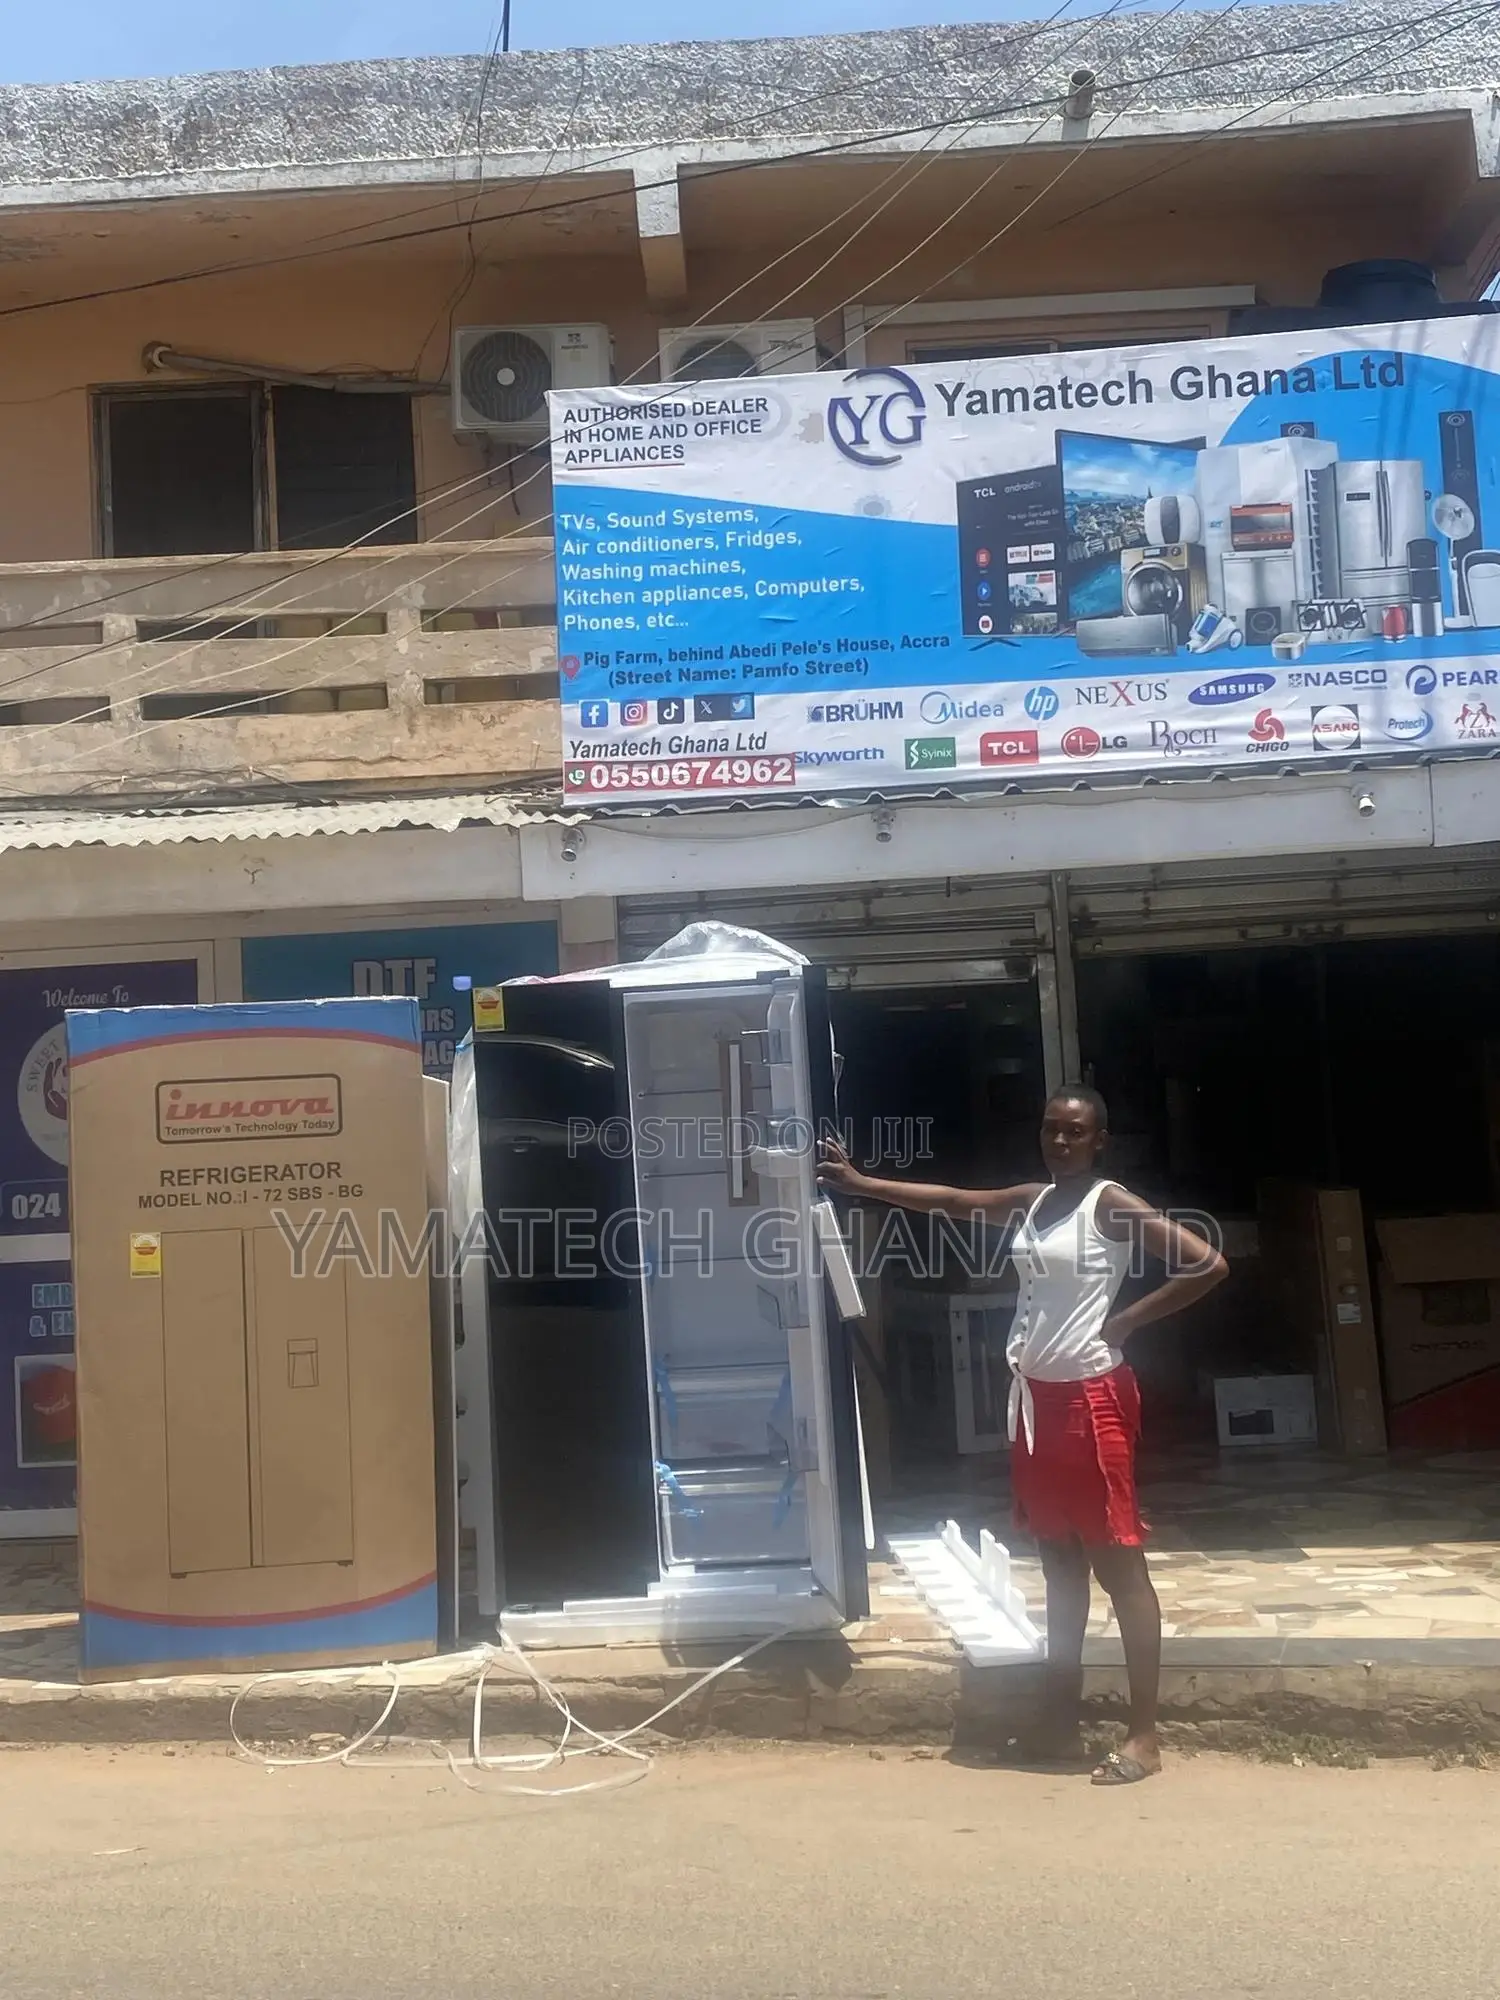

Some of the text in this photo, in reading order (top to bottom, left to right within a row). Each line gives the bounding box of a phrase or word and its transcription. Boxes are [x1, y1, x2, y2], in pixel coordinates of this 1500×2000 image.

[935, 353, 1404, 417] Yamatech Ghana Ltd
[563, 398, 769, 423] AUTHORISED DEALER
[830, 392, 927, 446] YG
[564, 419, 762, 444] IN HOME AND OFFICE
[564, 444, 685, 464] APPLIANCES
[974, 487, 996, 498] TCL
[560, 507, 759, 533] TVs, Sound Systems,
[562, 530, 802, 557] Air conditioners, Fridges,
[563, 559, 746, 583] Washing machines,
[563, 577, 865, 606] Kitchen appliances, Computers,
[564, 612, 689, 632] Phones, etc...
[584, 635, 950, 669] Pig Farm, behind Abedi Pele's House, Accra
[608, 659, 869, 688] (Street Name: Pamfo Street)
[1305, 669, 1387, 687] NASCO
[1442, 670, 1500, 687] PEAR
[1075, 681, 1168, 707] NEXUS
[1199, 682, 1265, 696] SAMSUNG
[825, 699, 903, 723] BRÜHM
[934, 701, 1004, 721] Midea
[1028, 687, 1056, 720] hp
[1312, 722, 1359, 733] ASANO
[1387, 716, 1425, 730] Protech
[1458, 728, 1496, 739] ZARA
[569, 731, 767, 759] Yamatech Ghana Ltd
[795, 747, 885, 766] Skyworth
[921, 748, 952, 758] Syinix
[988, 741, 1030, 755] TCL
[1246, 741, 1289, 753] CHIGO
[590, 757, 792, 788] 0550674962
[353, 958, 437, 999] DTF
[42, 984, 129, 1008] Welcome To
[27, 1039, 60, 1093] SWEET
[166, 1089, 335, 1121] innova
[165, 1119, 335, 1137] Tomorrow's Technology Today
[160, 1162, 342, 1187] REFRIGERATOR
[11, 1192, 61, 1220] 024
[139, 1194, 201, 1209] MODEL
[264, 1188, 282, 1202] 72
[288, 1186, 323, 1200] SBS
[338, 1184, 364, 1198] BG
